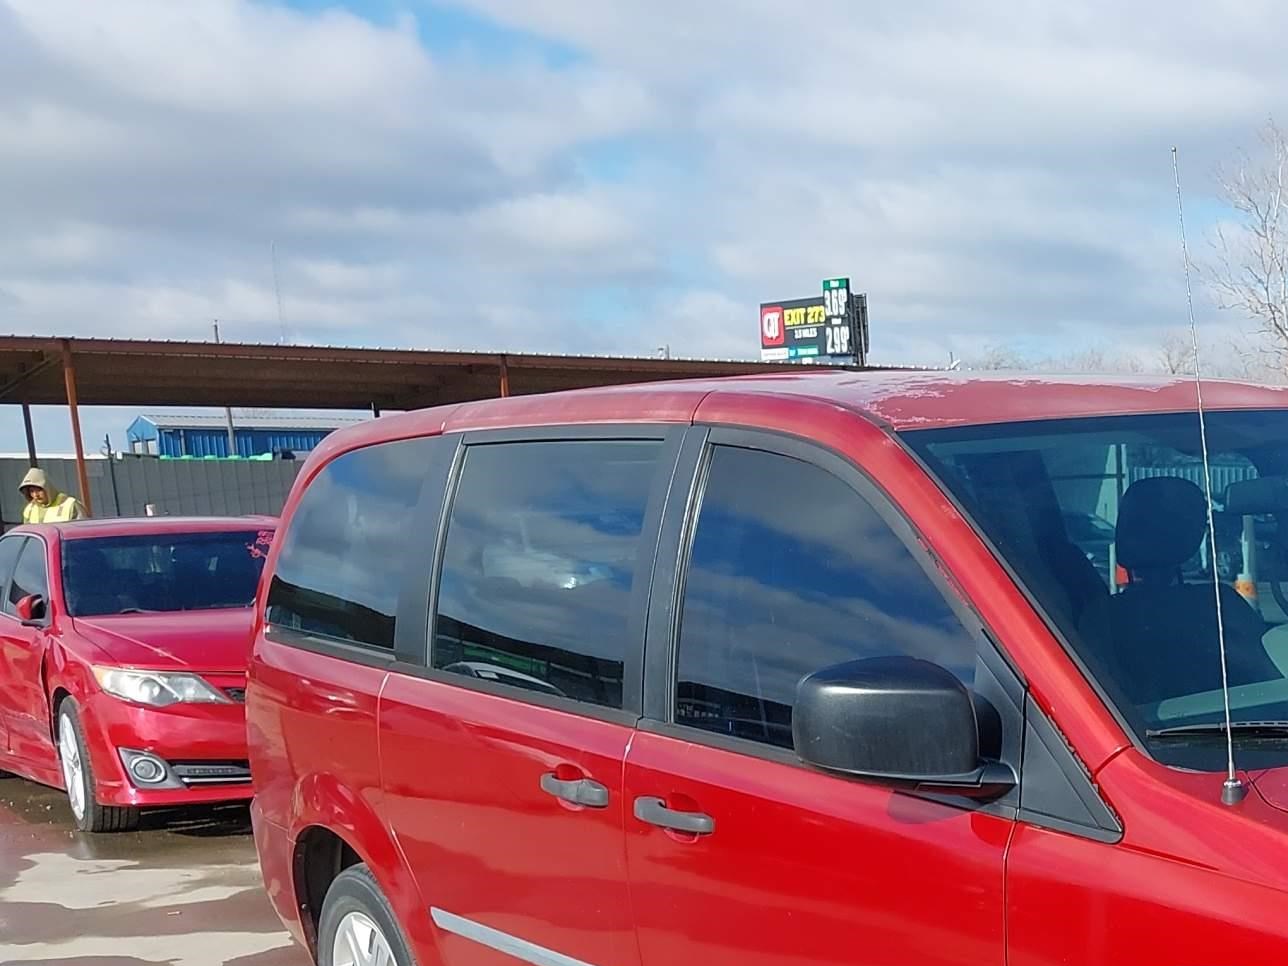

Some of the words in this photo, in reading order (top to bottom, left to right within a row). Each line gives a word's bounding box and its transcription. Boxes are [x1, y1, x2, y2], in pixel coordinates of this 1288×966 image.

[763, 312, 780, 340] QT
[784, 308, 806, 326] EXIT
[807, 305, 825, 324] 273
